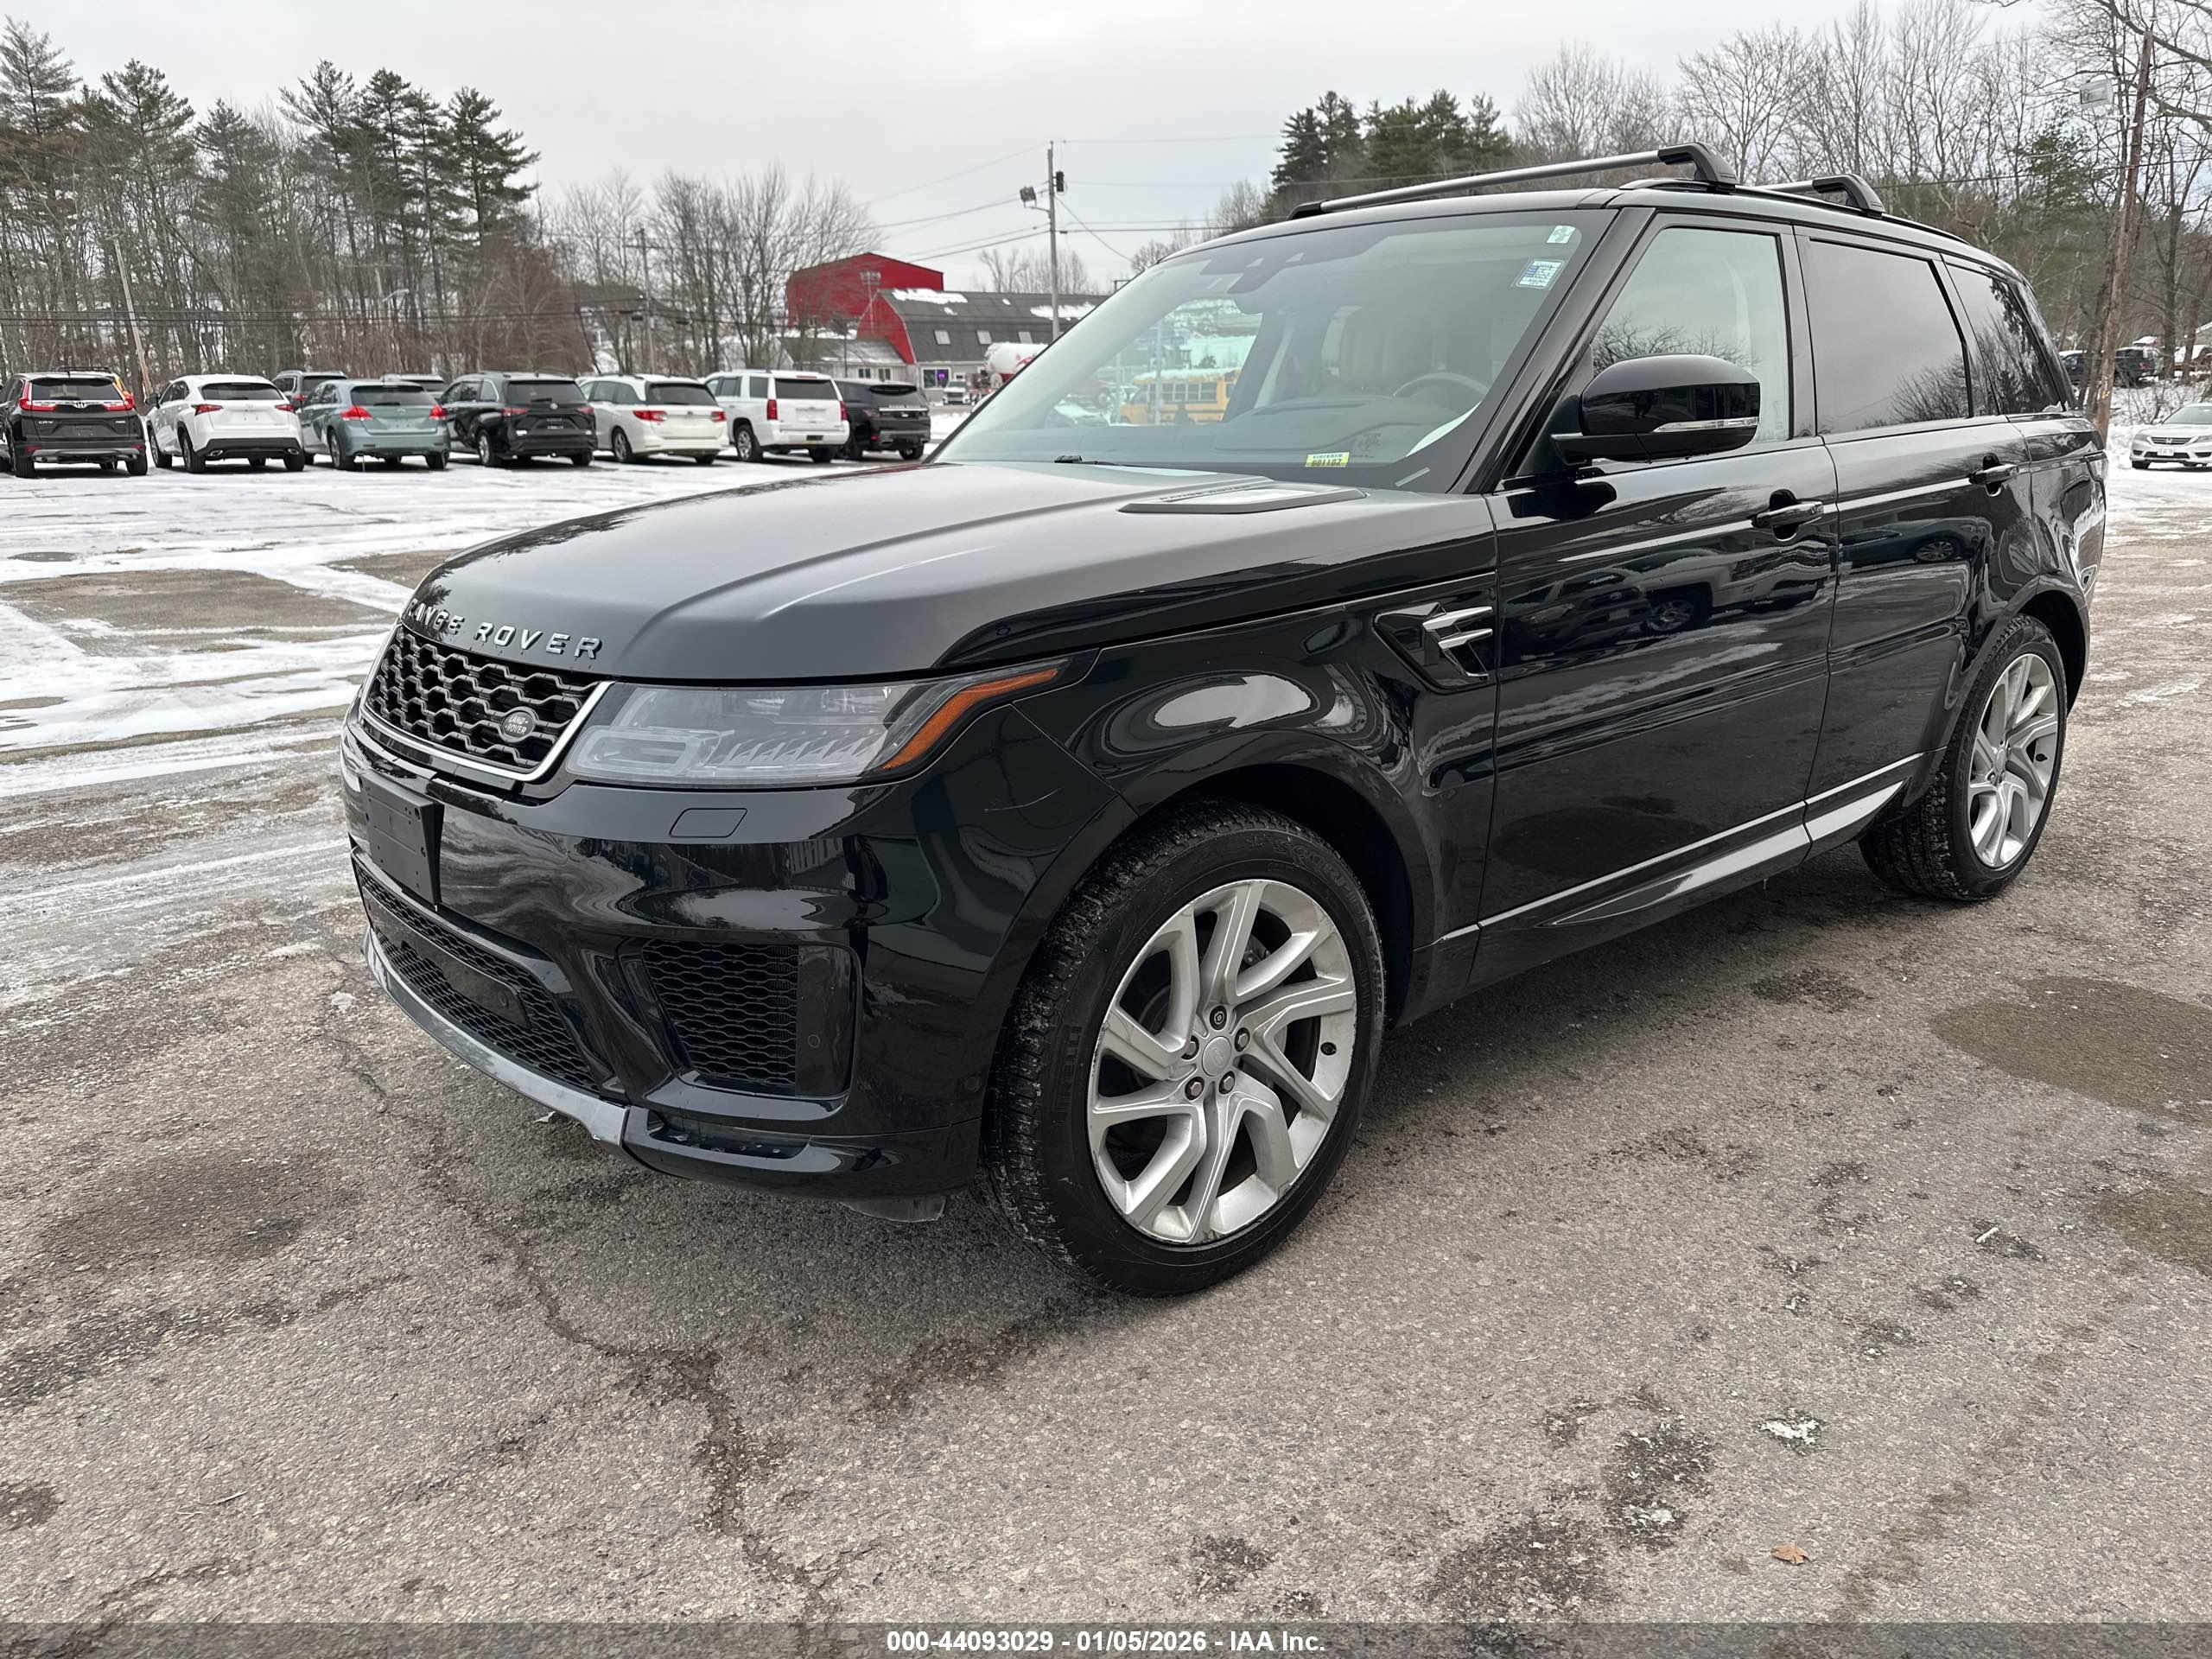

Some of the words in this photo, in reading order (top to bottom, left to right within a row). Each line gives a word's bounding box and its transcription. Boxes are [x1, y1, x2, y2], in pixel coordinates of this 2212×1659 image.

[406, 598, 465, 635] RANGE
[474, 621, 602, 659] ROVER
[508, 715, 526, 725] LAND
[506, 723, 527, 735] ROVER
